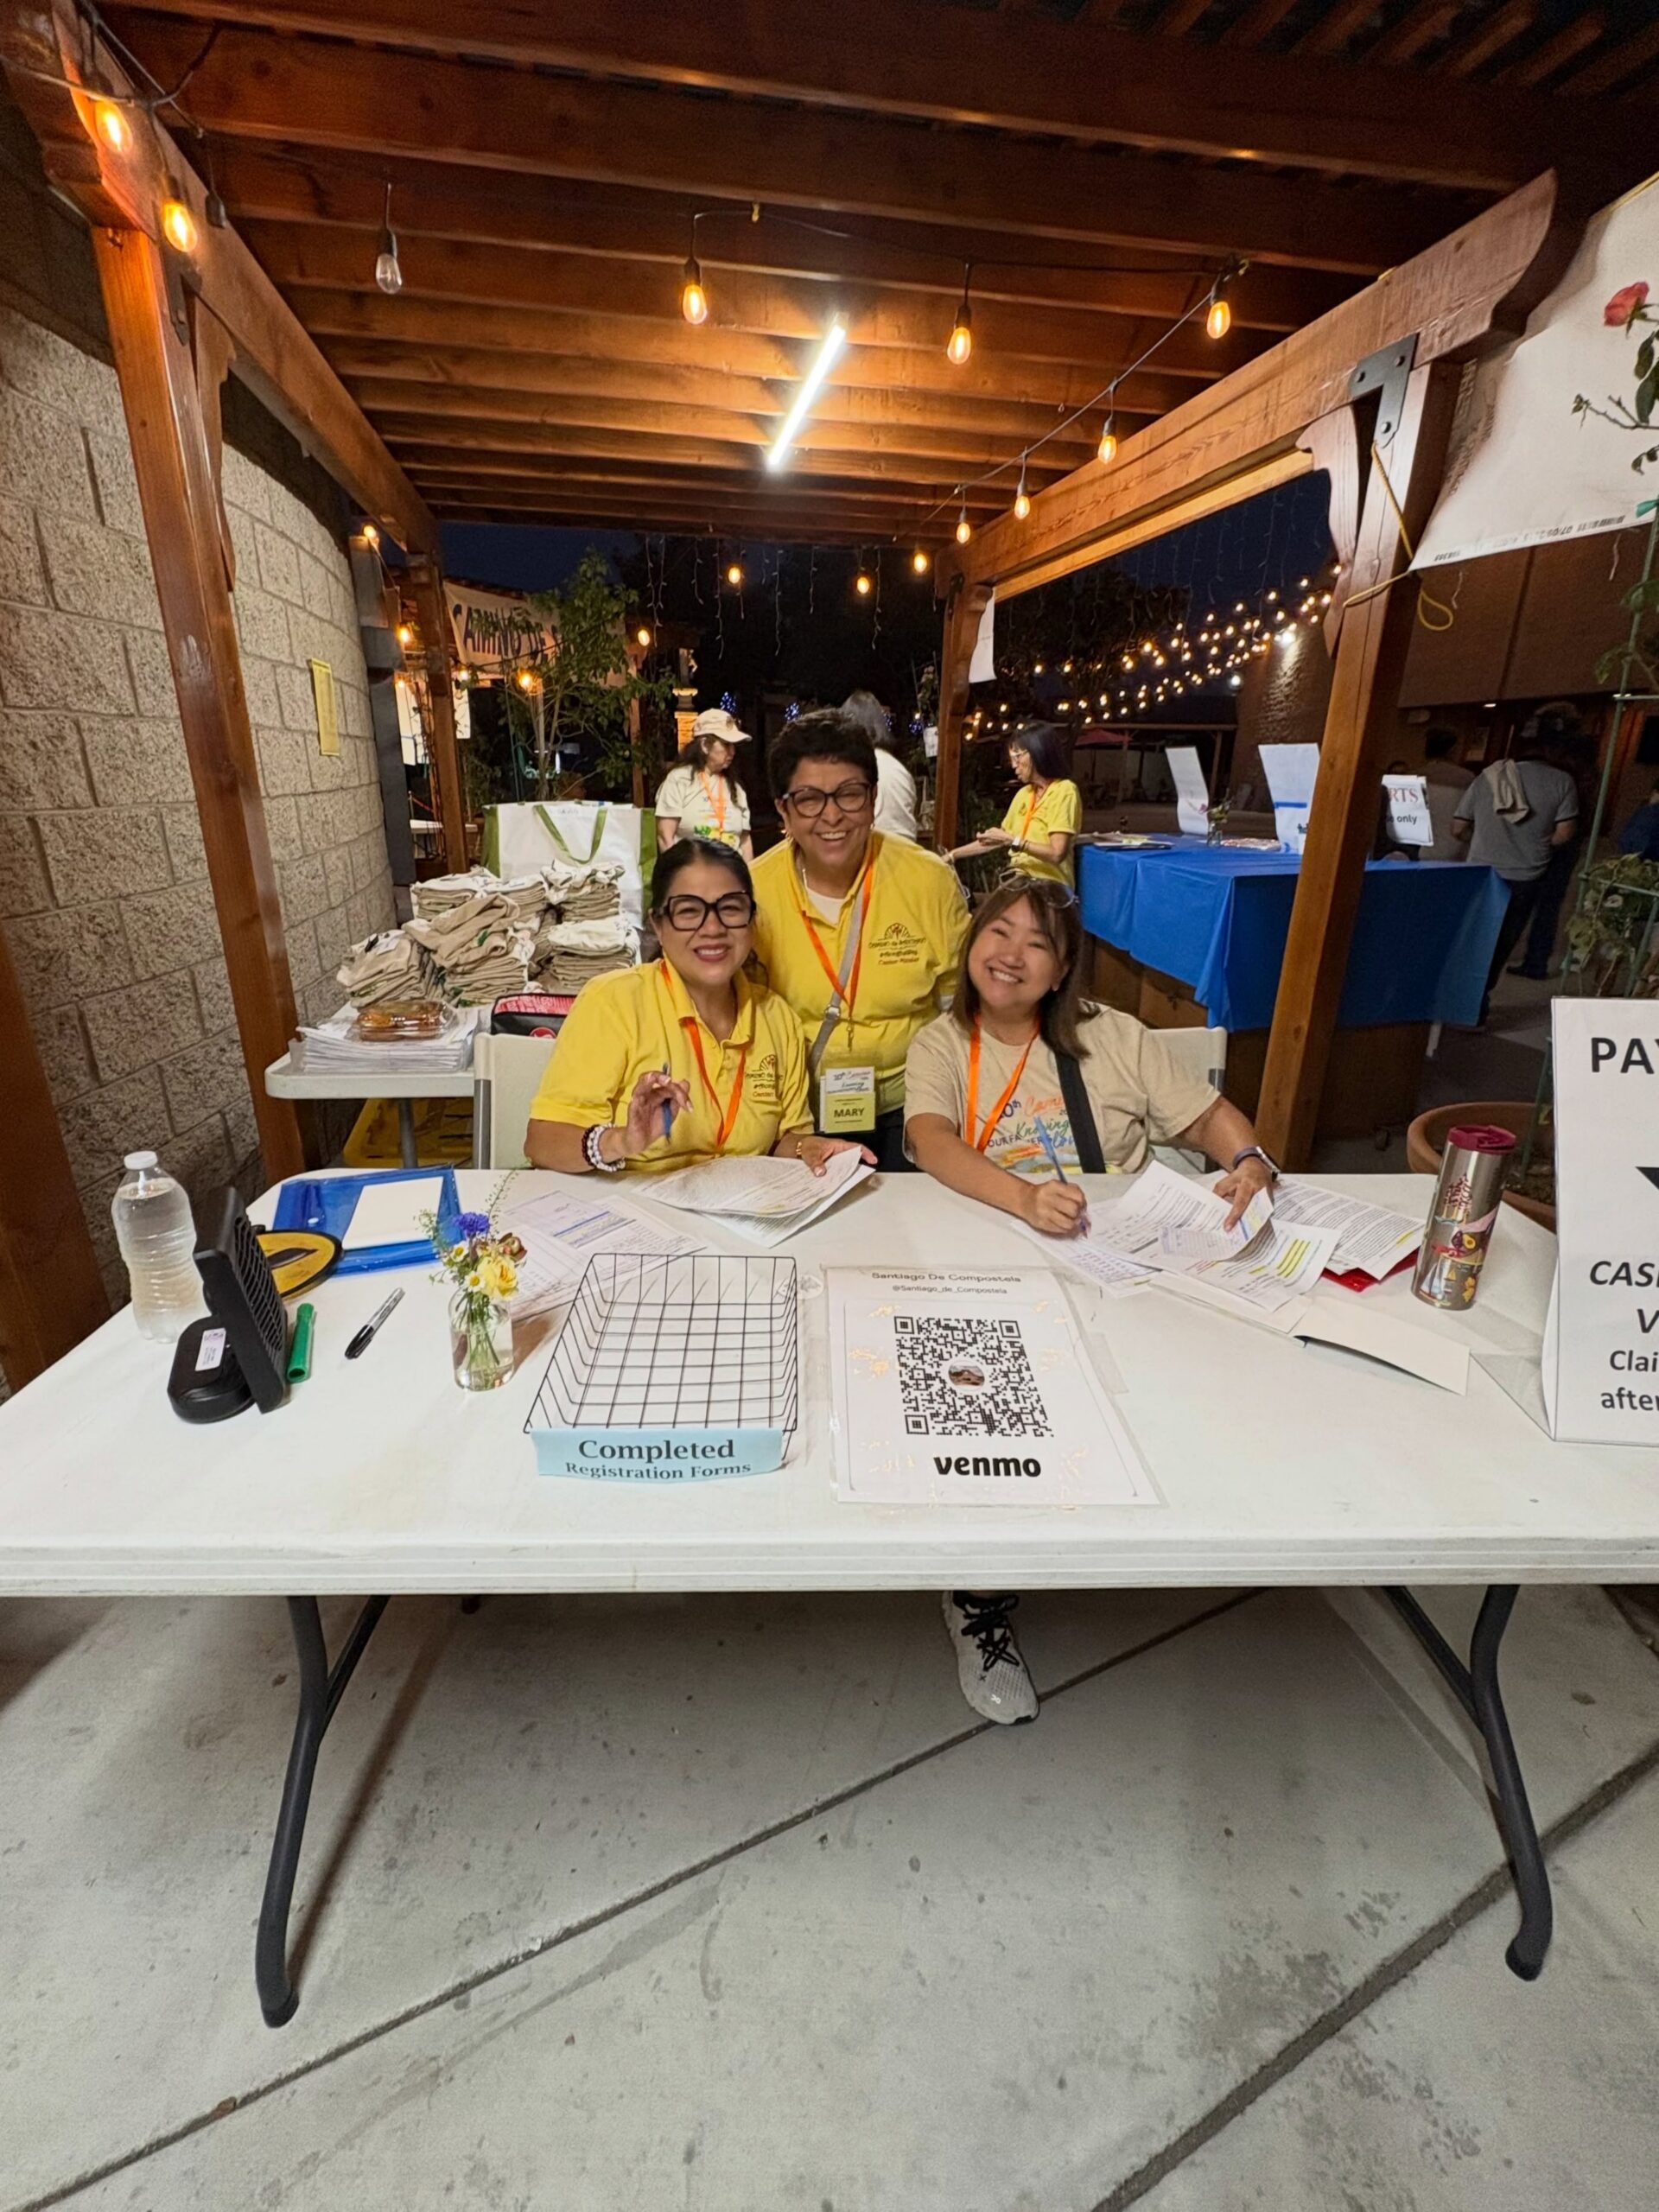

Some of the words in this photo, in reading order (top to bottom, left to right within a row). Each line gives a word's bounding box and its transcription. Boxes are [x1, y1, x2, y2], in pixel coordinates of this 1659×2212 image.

[1388, 787, 1419, 803] RTS
[1396, 814, 1417, 826] only
[1591, 1037, 1659, 1075] PA
[834, 1108, 865, 1118] MARY
[872, 1272, 925, 1281] Santiago
[948, 1274, 1021, 1283] Compostela
[1590, 1261, 1659, 1288] CAS
[578, 1440, 735, 1464] Completed
[565, 1462, 683, 1480] Registration
[691, 1463, 752, 1478] Forms
[933, 1456, 1042, 1478] venmo
